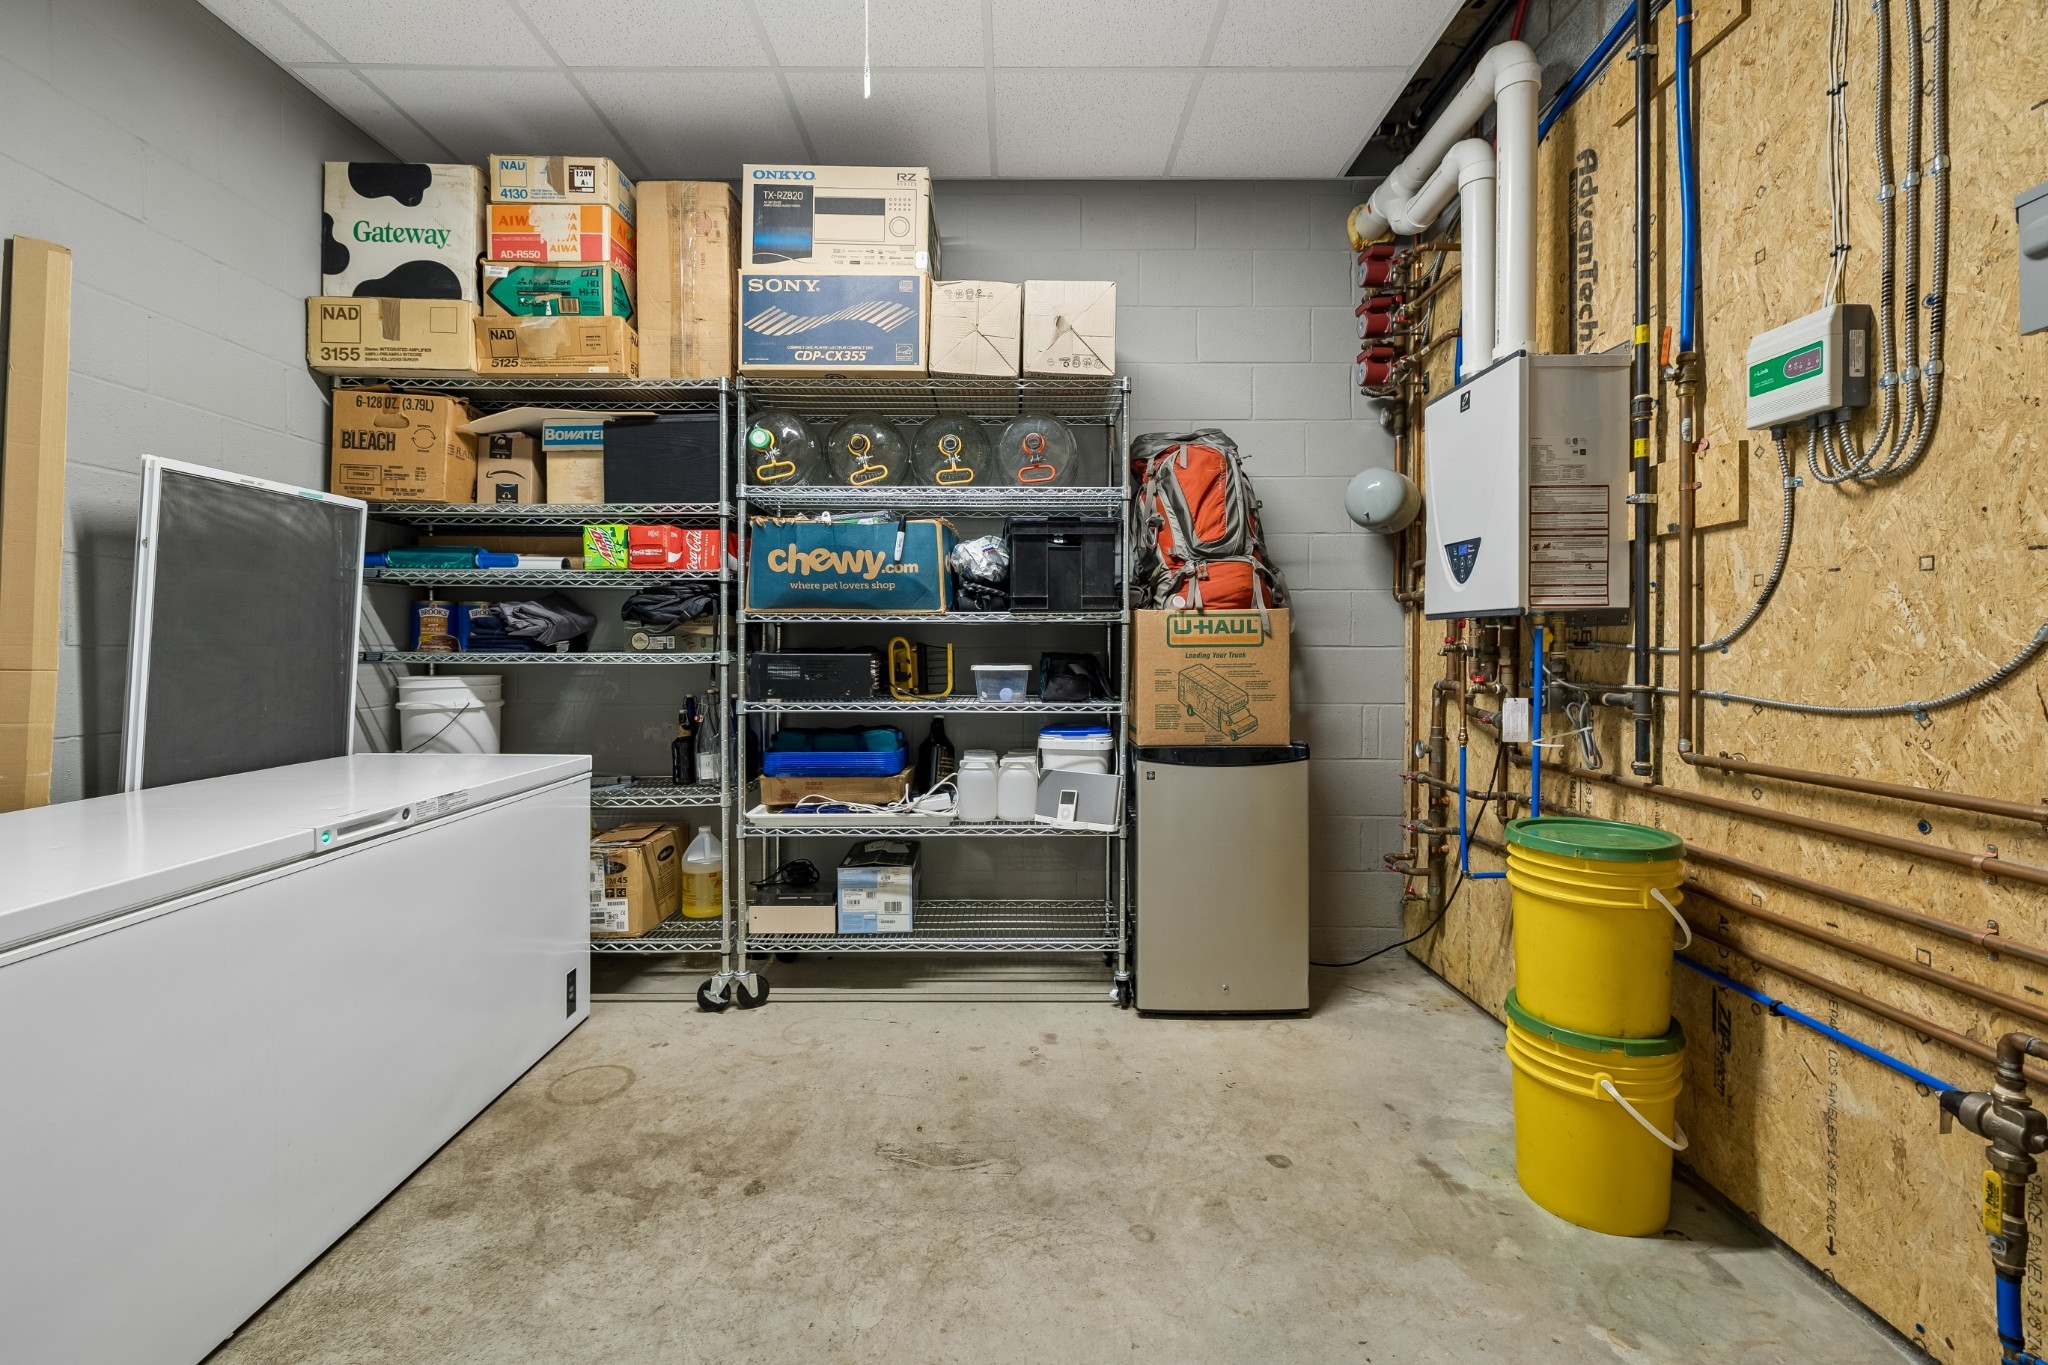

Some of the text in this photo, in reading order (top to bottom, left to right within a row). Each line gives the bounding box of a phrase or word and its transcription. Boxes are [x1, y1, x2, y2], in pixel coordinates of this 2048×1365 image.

[501, 161, 525, 170] NAD
[752, 170, 816, 181] ONKYO
[897, 173, 916, 181] RZ
[501, 188, 528, 199] 4130
[763, 191, 803, 200] TX-RZ820
[499, 215, 530, 226] AIW
[353, 220, 451, 249] Gateway
[549, 245, 578, 253] AIWA
[1576, 148, 1598, 342] AdvanTech
[500, 251, 540, 259] AD-R550
[748, 279, 820, 292] SONY
[323, 307, 359, 320] NAD
[490, 330, 515, 340] NAD
[321, 347, 360, 361] 3155
[794, 350, 866, 361] CDP-CX355
[491, 359, 519, 367] 5125
[356, 395, 435, 412] 6-128 OZ. (3.79L)
[340, 429, 396, 451] BLEACH
[545, 429, 604, 441] BOWATE
[768, 543, 919, 580] chewy.com
[790, 581, 896, 591] where pet lovers shop
[1173, 619, 1258, 634] U-HAUL
[1185, 652, 1211, 660] Loading
[1828, 1049, 1838, 1076] LOS
[1827, 1081, 1838, 1144] PANELES
[1826, 1173, 1837, 1194] DE
[2028, 1174, 2043, 1228] SPACE
[1825, 1199, 1836, 1236] PULG
[2027, 1232, 2043, 1298] PANELS
[2027, 1301, 2043, 1331] 1/8
